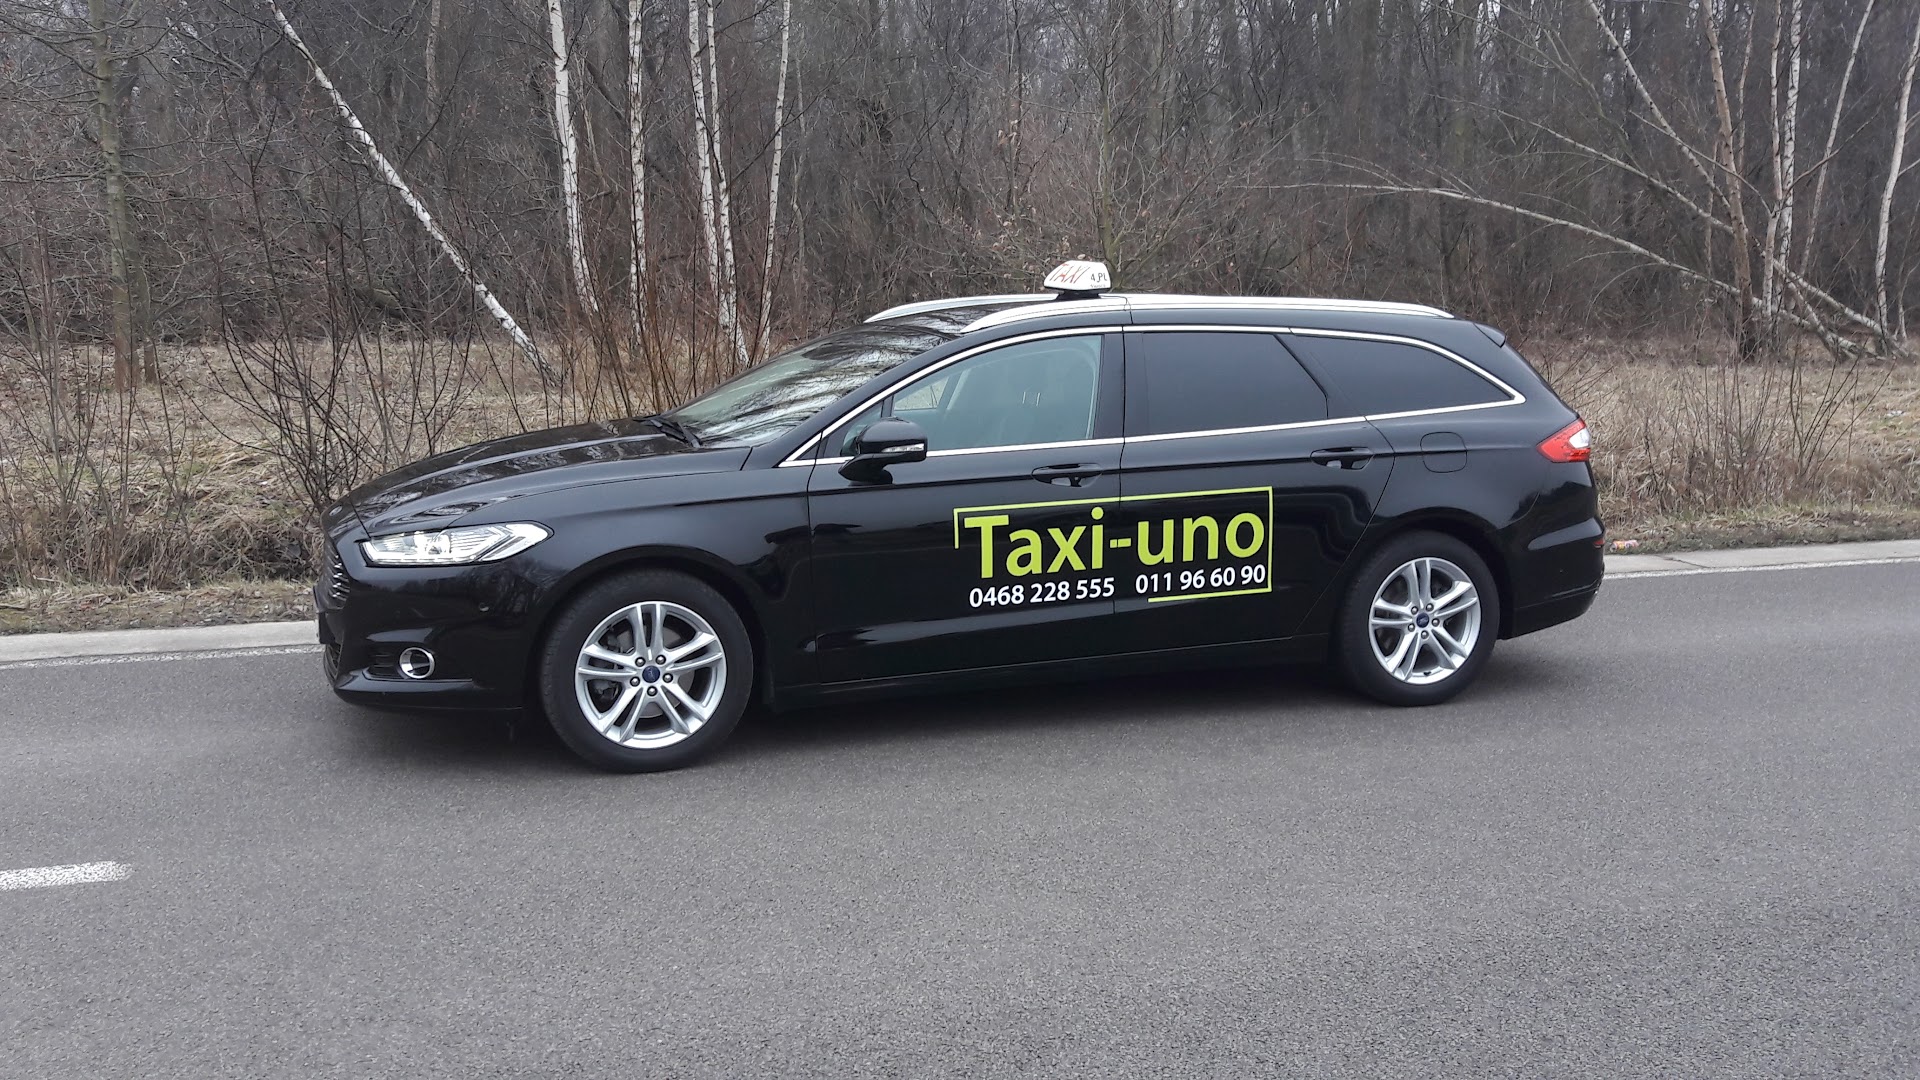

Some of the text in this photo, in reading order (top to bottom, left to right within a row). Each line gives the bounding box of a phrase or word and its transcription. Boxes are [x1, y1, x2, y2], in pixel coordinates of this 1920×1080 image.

[1049, 264, 1091, 283] TAXI
[964, 506, 1265, 579] Taxi-uno
[969, 564, 1267, 608] 0468 228 555 011 96 60 90
